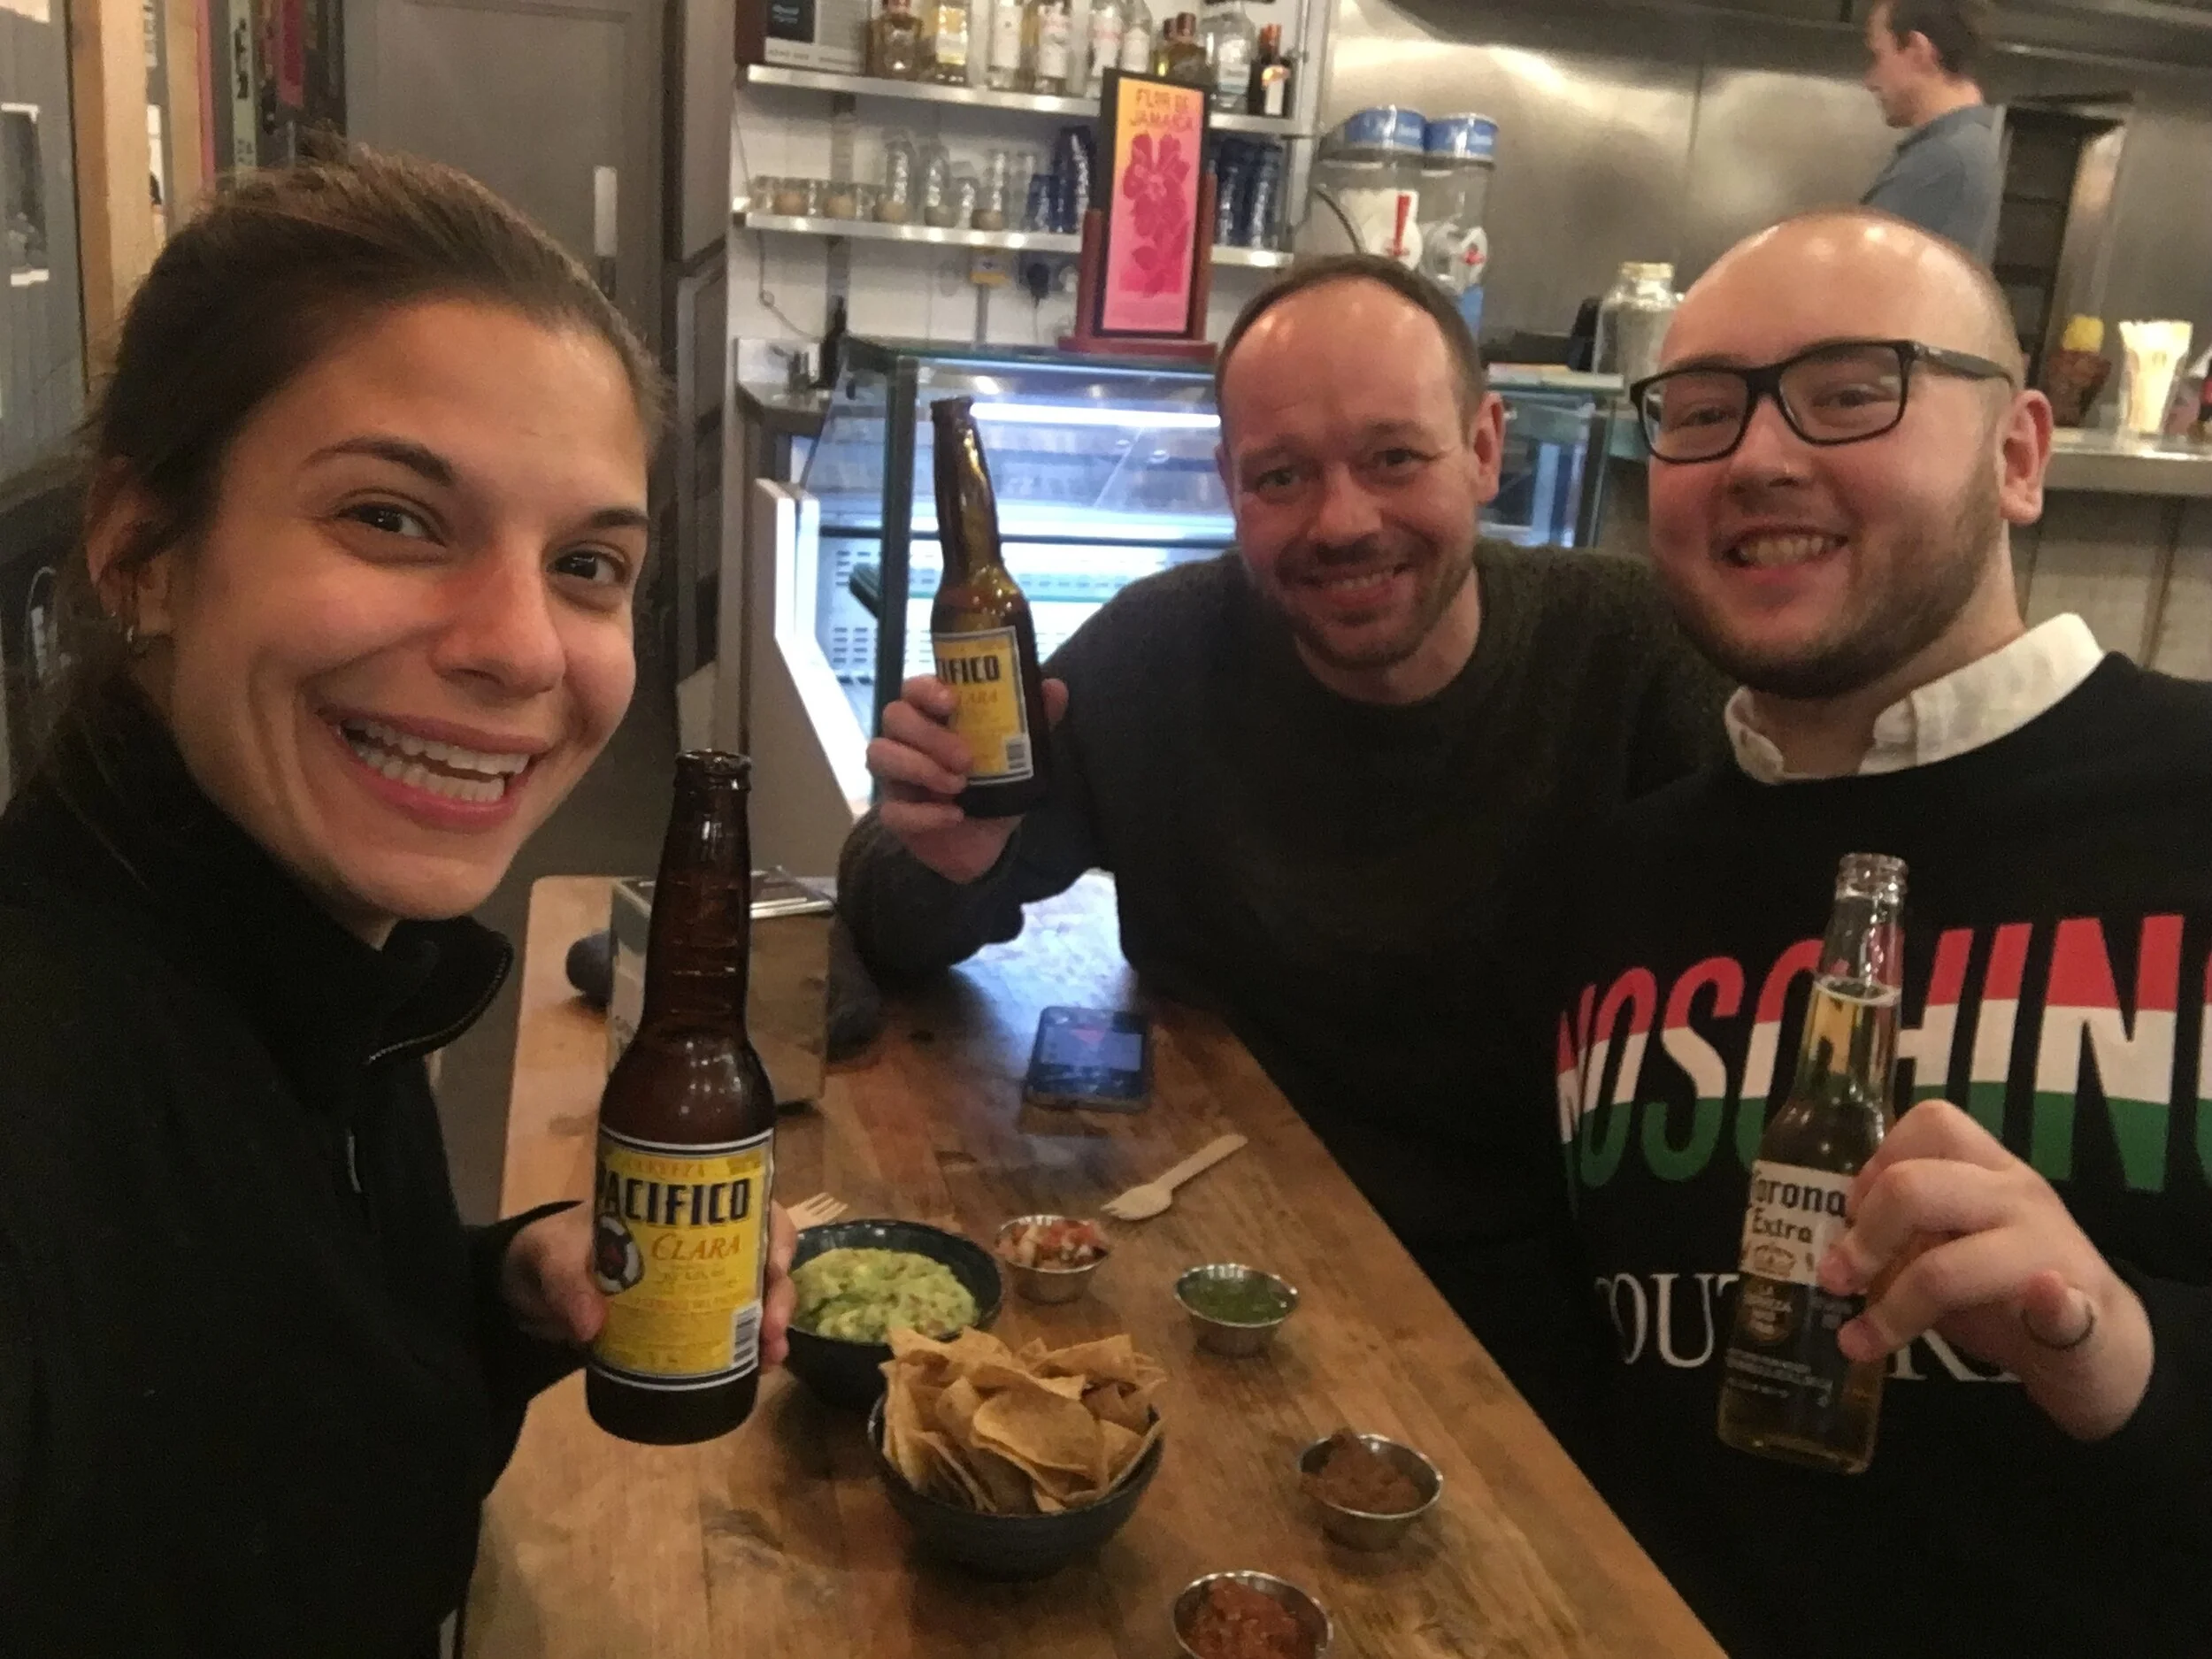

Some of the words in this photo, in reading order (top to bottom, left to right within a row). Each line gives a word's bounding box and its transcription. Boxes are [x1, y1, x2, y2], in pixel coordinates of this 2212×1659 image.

[1557, 913, 2212, 1218] MOSCHIN
[1754, 1168, 1851, 1221] orona
[1752, 1207, 1813, 1244] Extra
